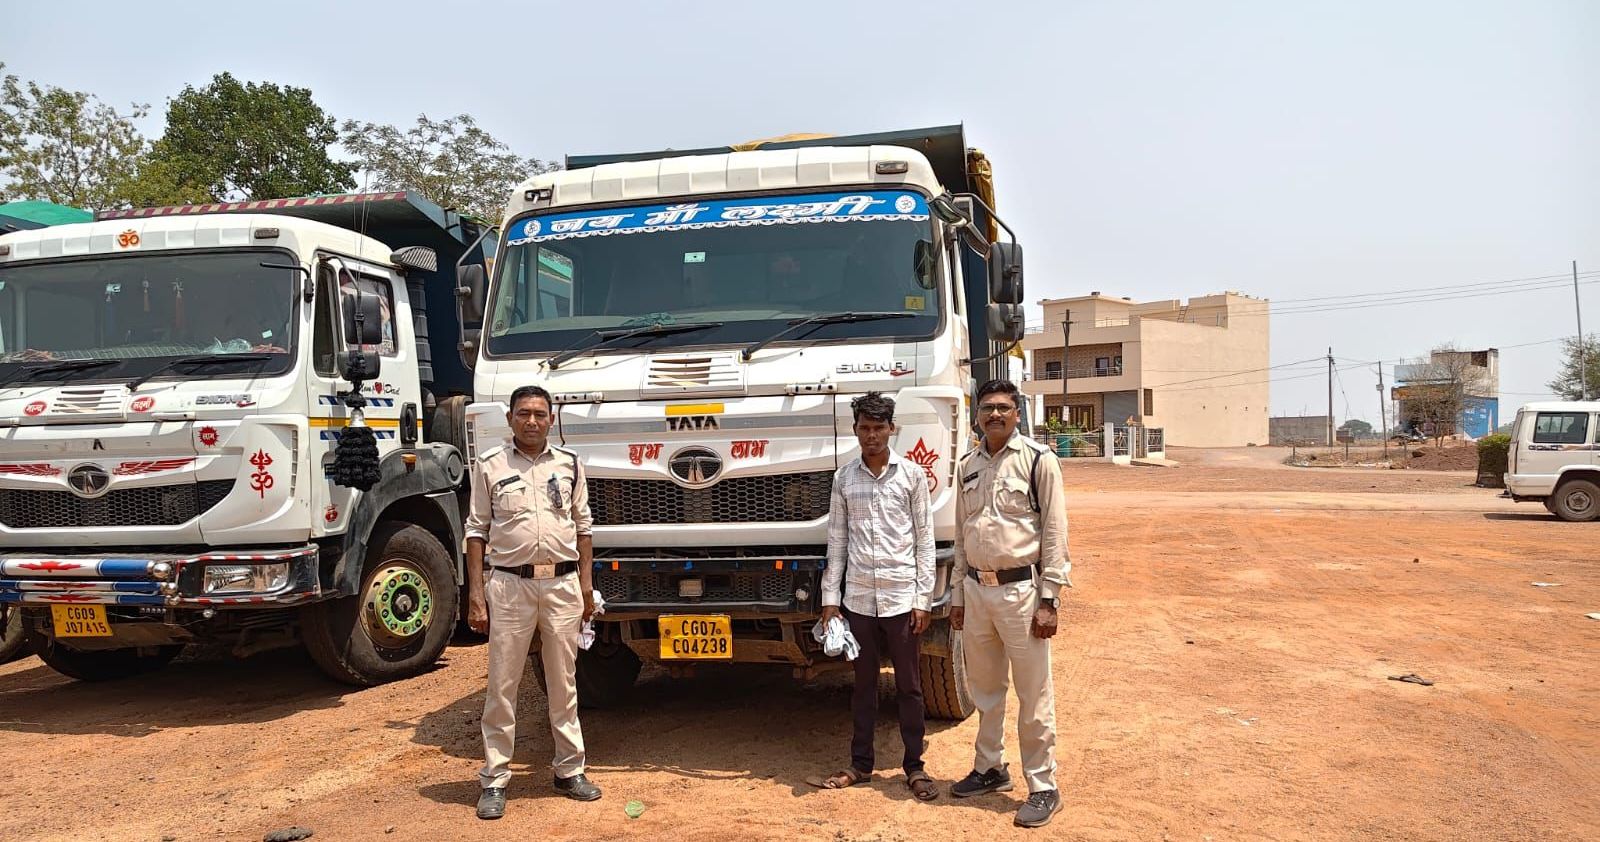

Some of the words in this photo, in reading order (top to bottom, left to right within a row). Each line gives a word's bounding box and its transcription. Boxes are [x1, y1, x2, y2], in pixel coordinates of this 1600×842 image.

[551, 213, 634, 233] जय
[720, 195, 886, 219] लक्ष्मी
[836, 361, 908, 374] SIGNA
[195, 393, 253, 405] SIGNA
[665, 415, 719, 431] TATA
[731, 440, 769, 459] लाभ
[67, 607, 96, 620] CG09
[681, 620, 717, 636] CG07
[673, 638, 727, 654] CQ4238
